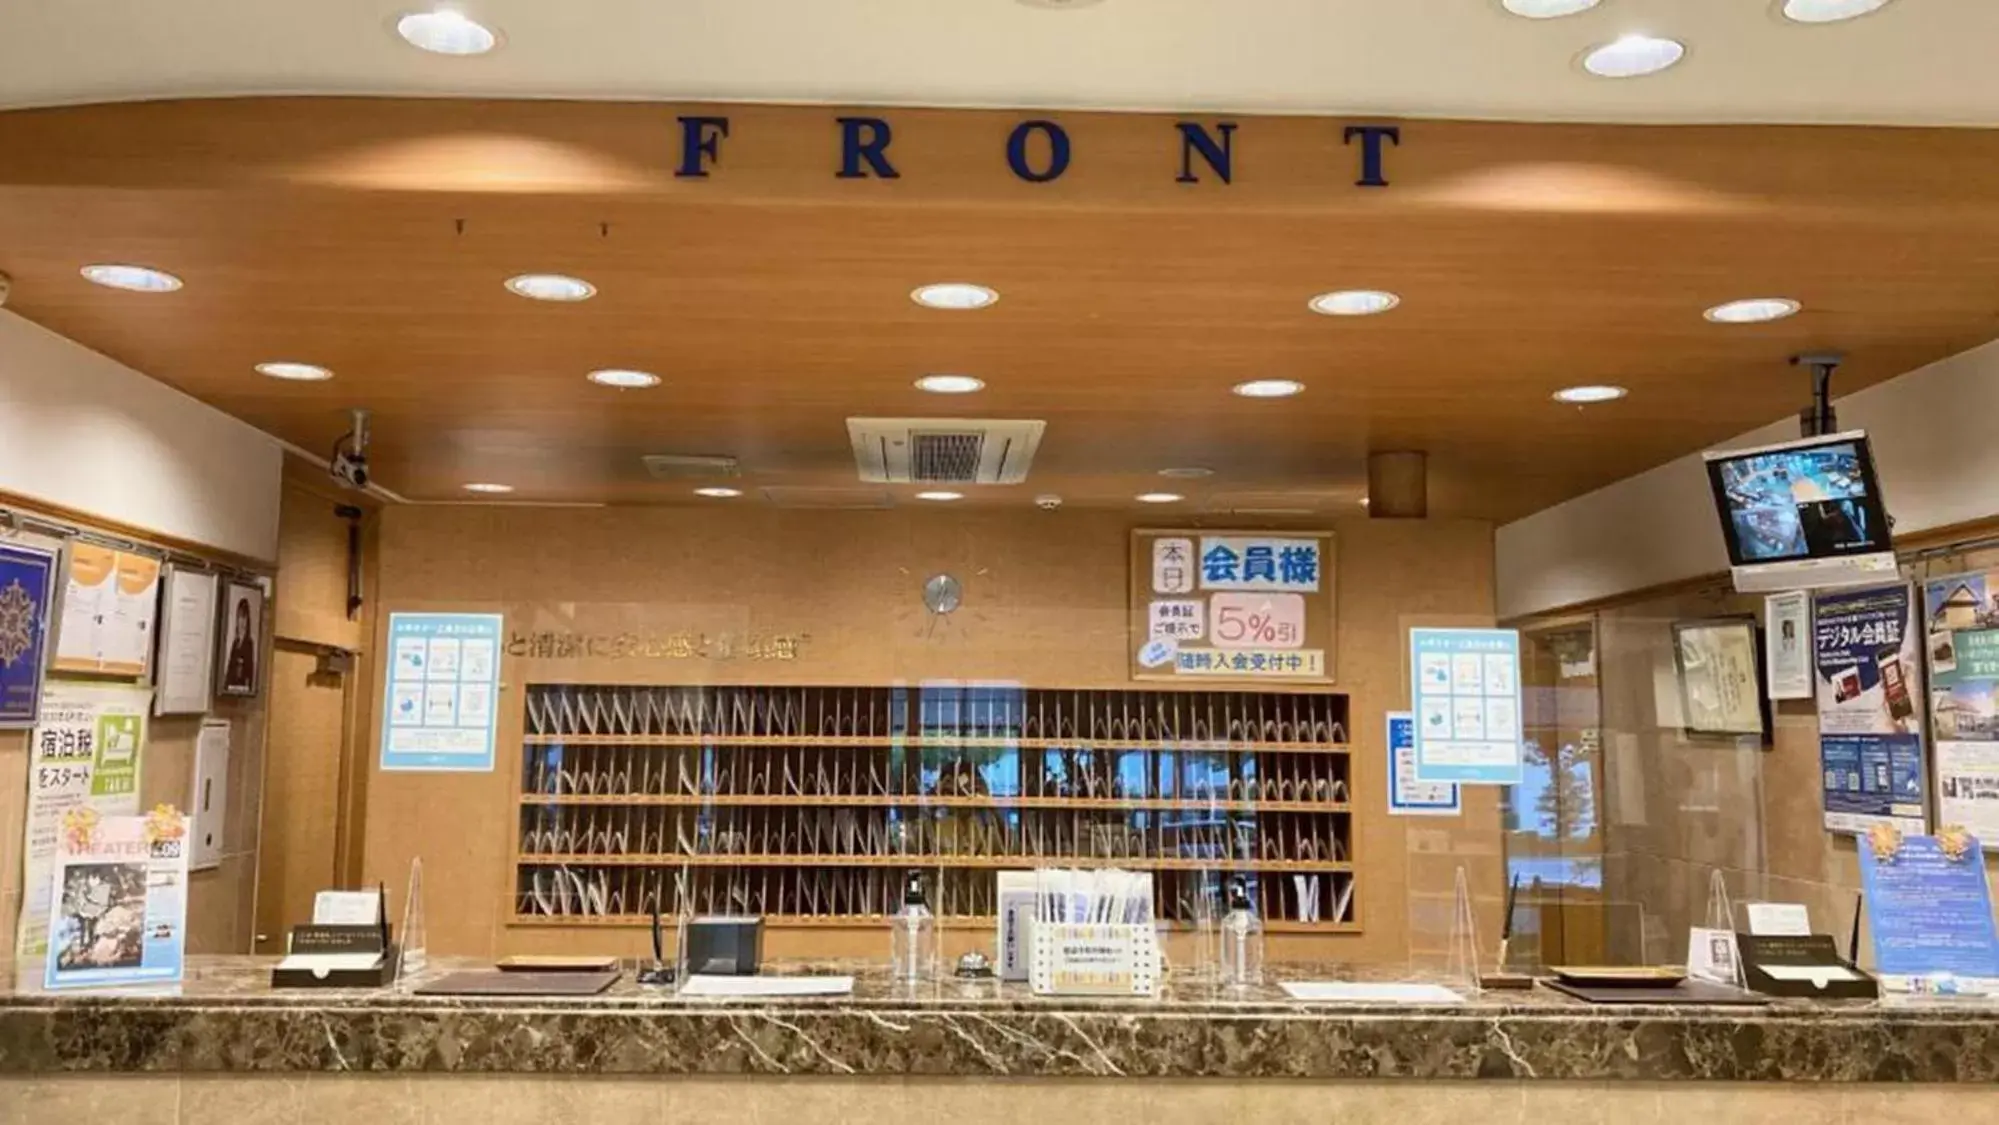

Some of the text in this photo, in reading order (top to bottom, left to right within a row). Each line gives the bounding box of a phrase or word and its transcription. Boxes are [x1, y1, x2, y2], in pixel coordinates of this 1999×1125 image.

[675, 116, 1400, 186] FRONT
[1163, 543, 1184, 591] 本日
[1202, 544, 1317, 584] 会員様
[1158, 604, 1195, 618] 会員証
[1217, 606, 1297, 643] 5%引
[1818, 620, 1901, 649] デジタル会員証
[41, 729, 93, 758] 宿泊税
[38, 766, 89, 788] をスタート
